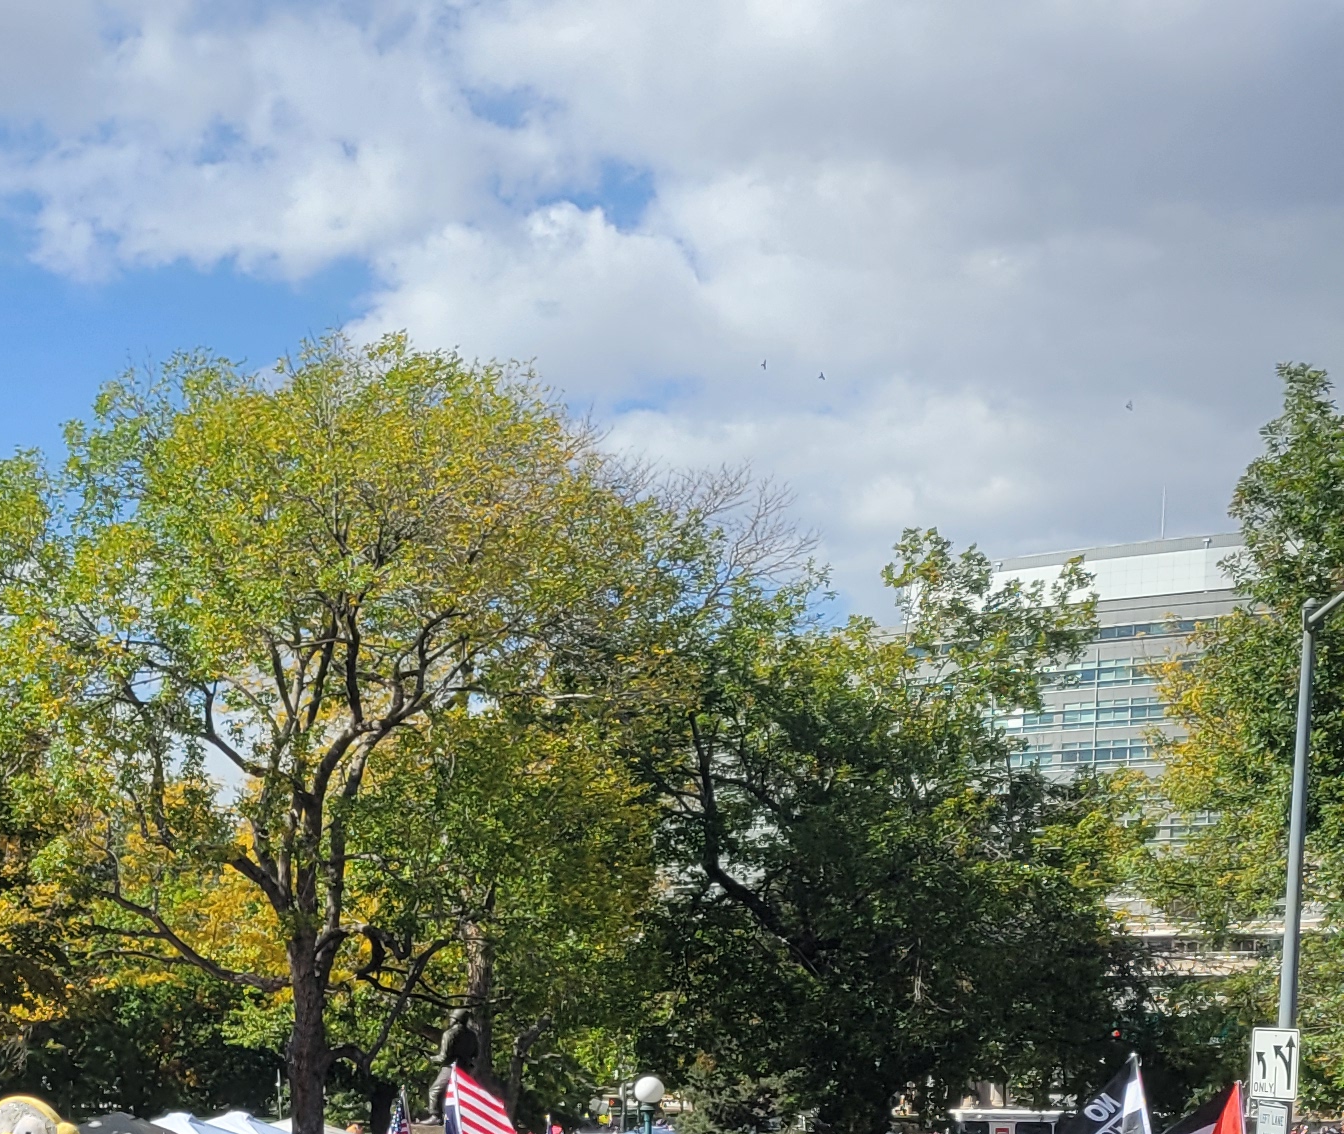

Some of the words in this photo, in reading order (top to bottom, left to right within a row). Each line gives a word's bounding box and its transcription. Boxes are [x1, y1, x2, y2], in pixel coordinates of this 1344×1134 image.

[1254, 1082, 1273, 1093] ONLY
[1259, 1113, 1270, 1124] LEFT
[1271, 1115, 1284, 1127] LANE
